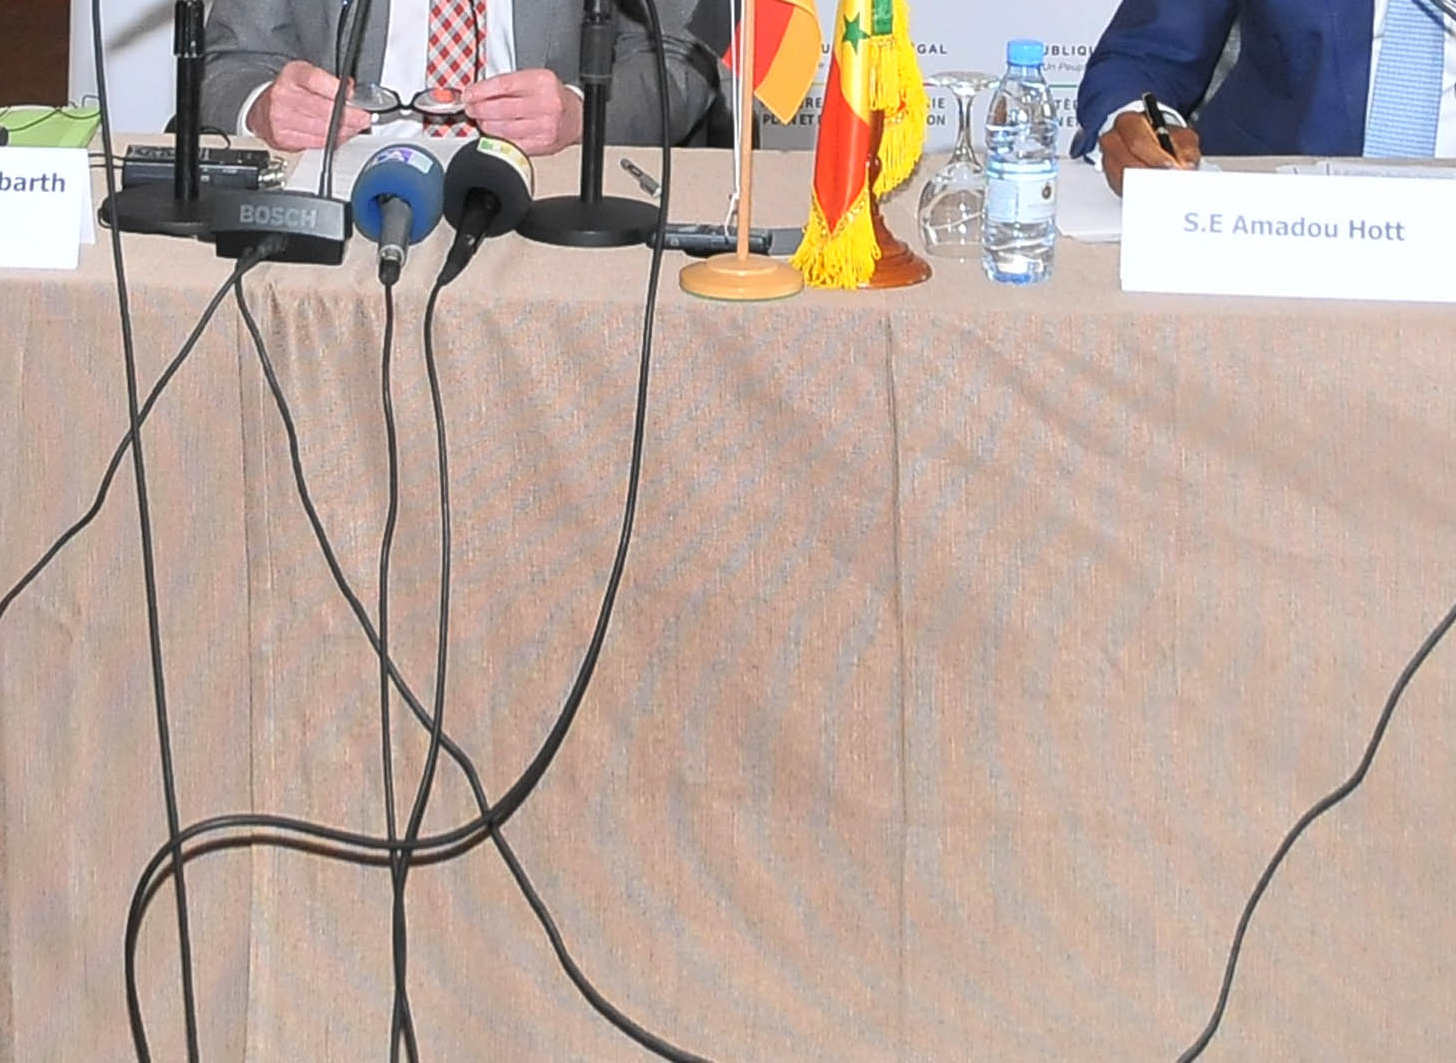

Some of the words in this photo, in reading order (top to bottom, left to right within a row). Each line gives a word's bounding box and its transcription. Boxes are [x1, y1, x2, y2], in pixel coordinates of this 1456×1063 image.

[239, 203, 318, 229] BOSCH
[1183, 212, 1223, 233] S.E
[1231, 215, 1339, 238] Amadou
[1348, 219, 1405, 242] Hott
